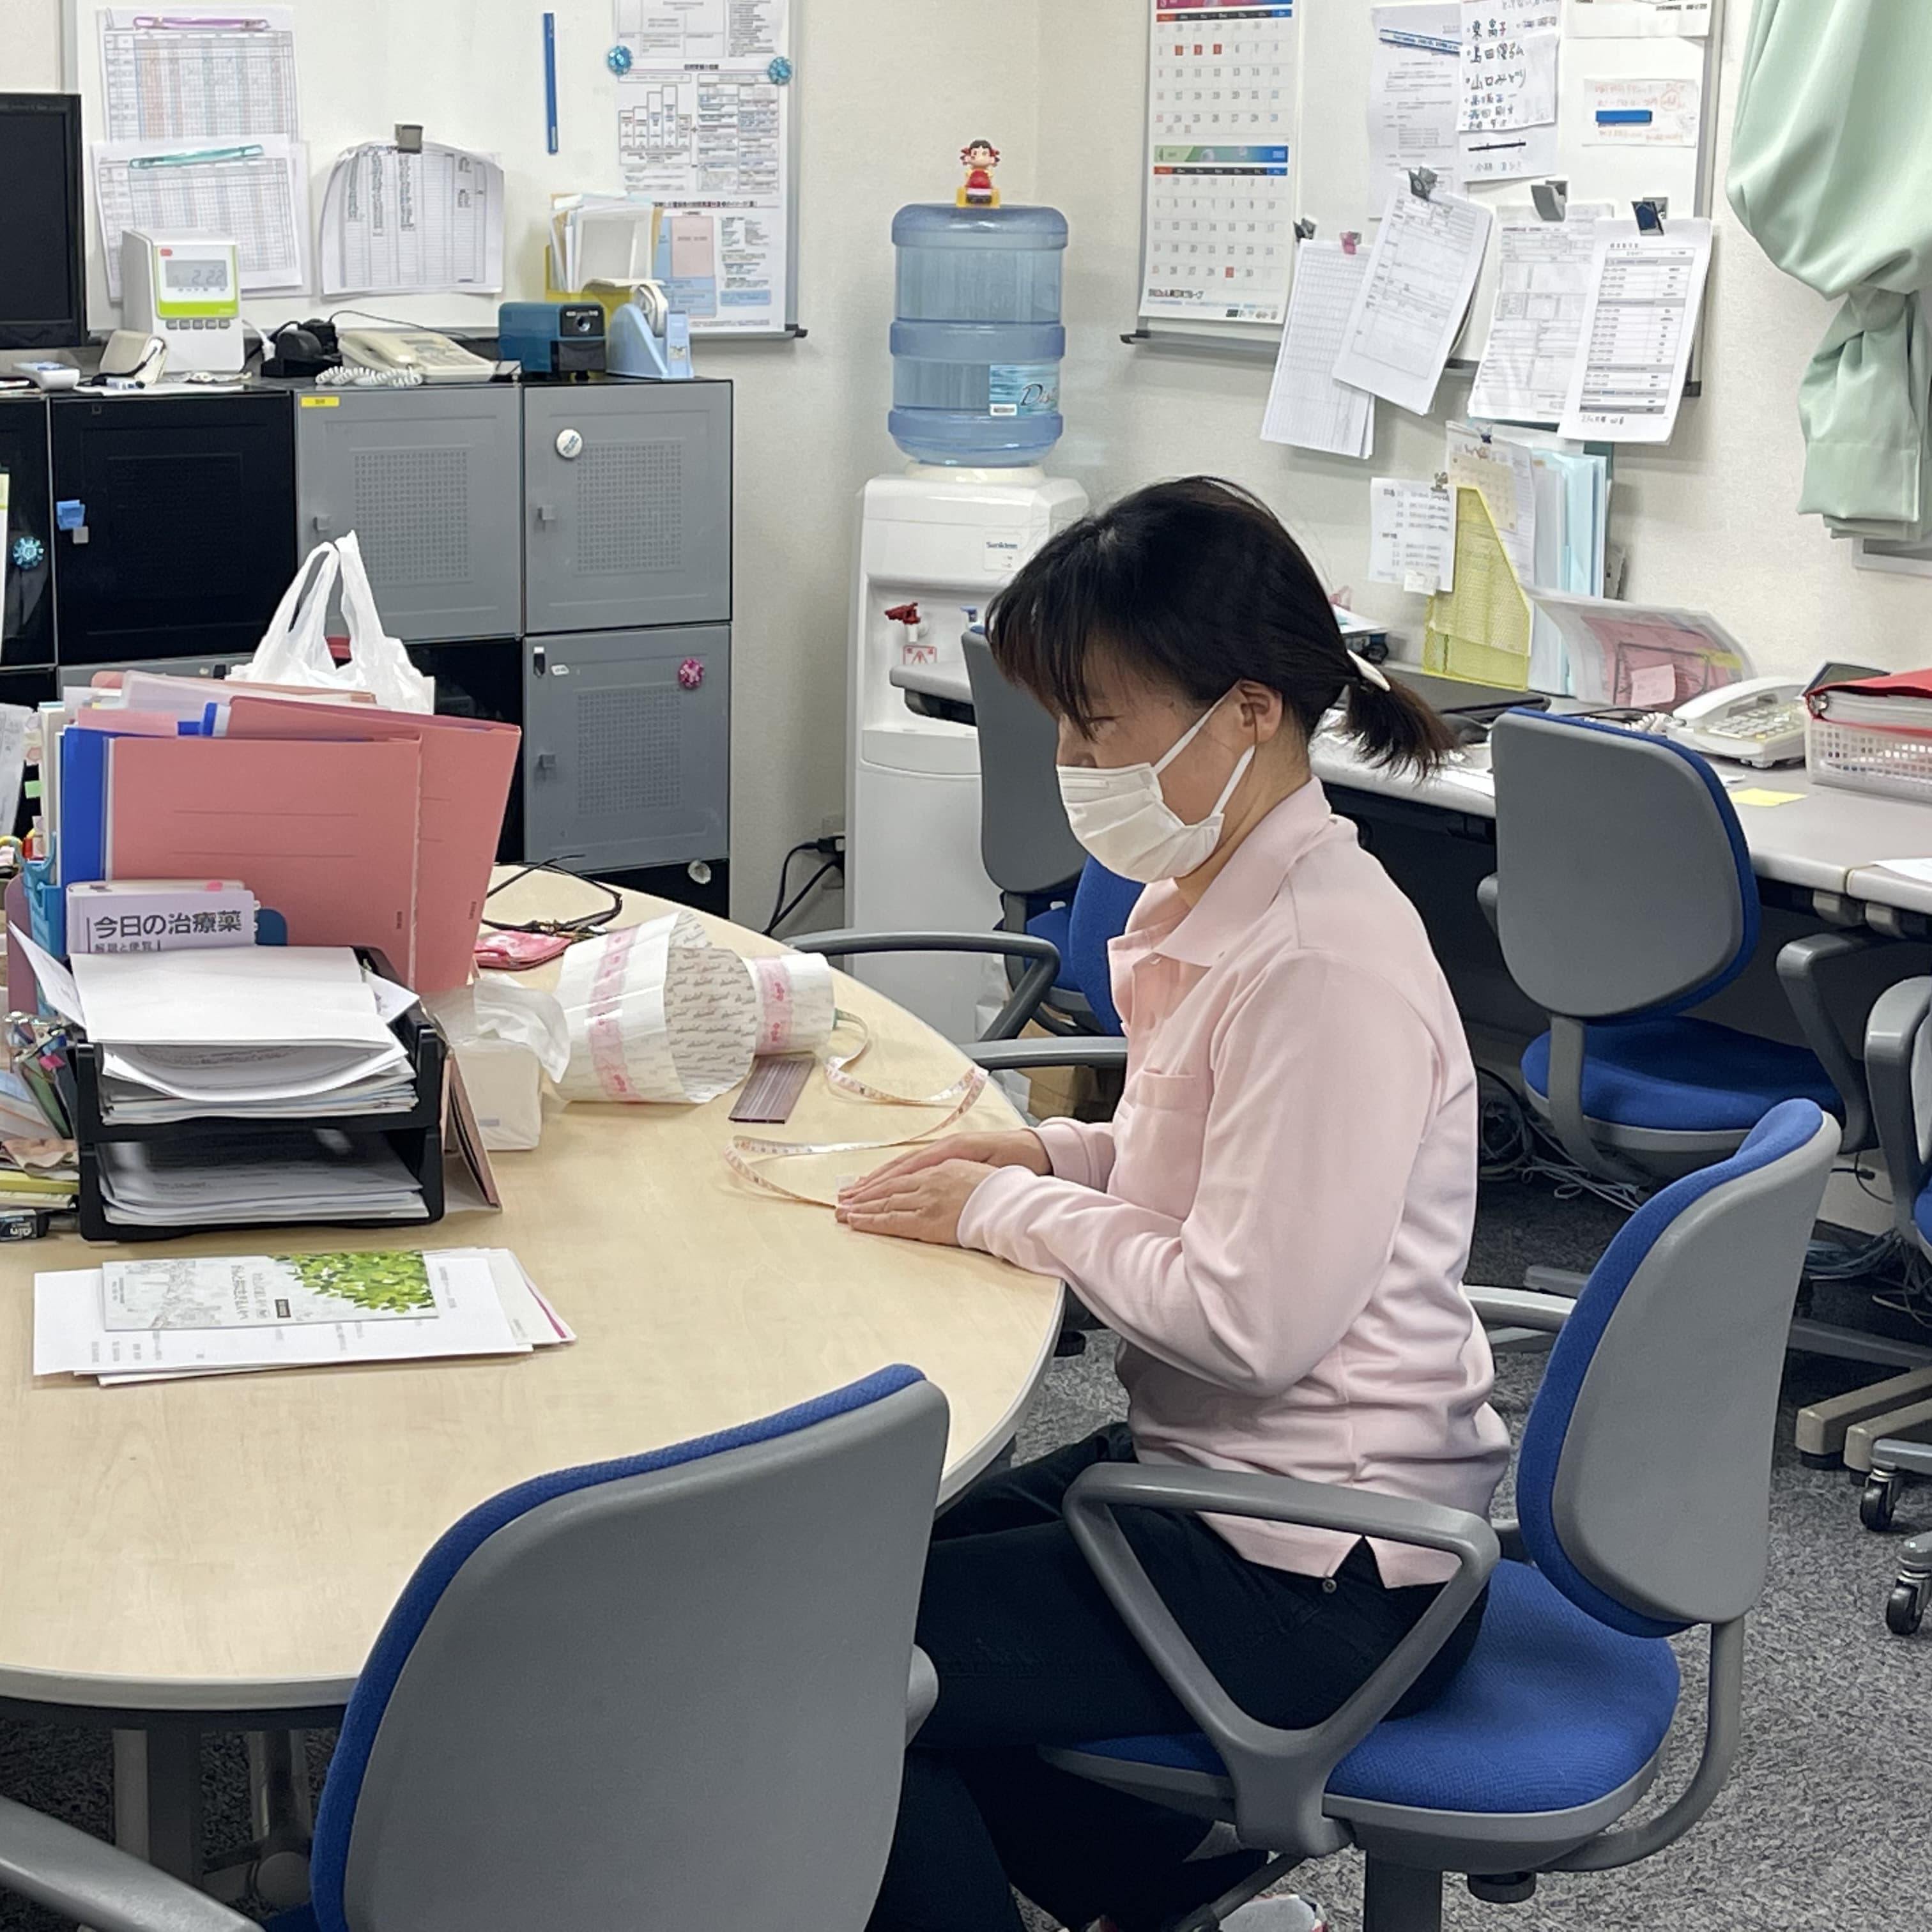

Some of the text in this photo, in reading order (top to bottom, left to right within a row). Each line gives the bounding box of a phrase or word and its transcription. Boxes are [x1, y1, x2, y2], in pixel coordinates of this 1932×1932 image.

[93, 910, 242, 939] 今日の治療薬
